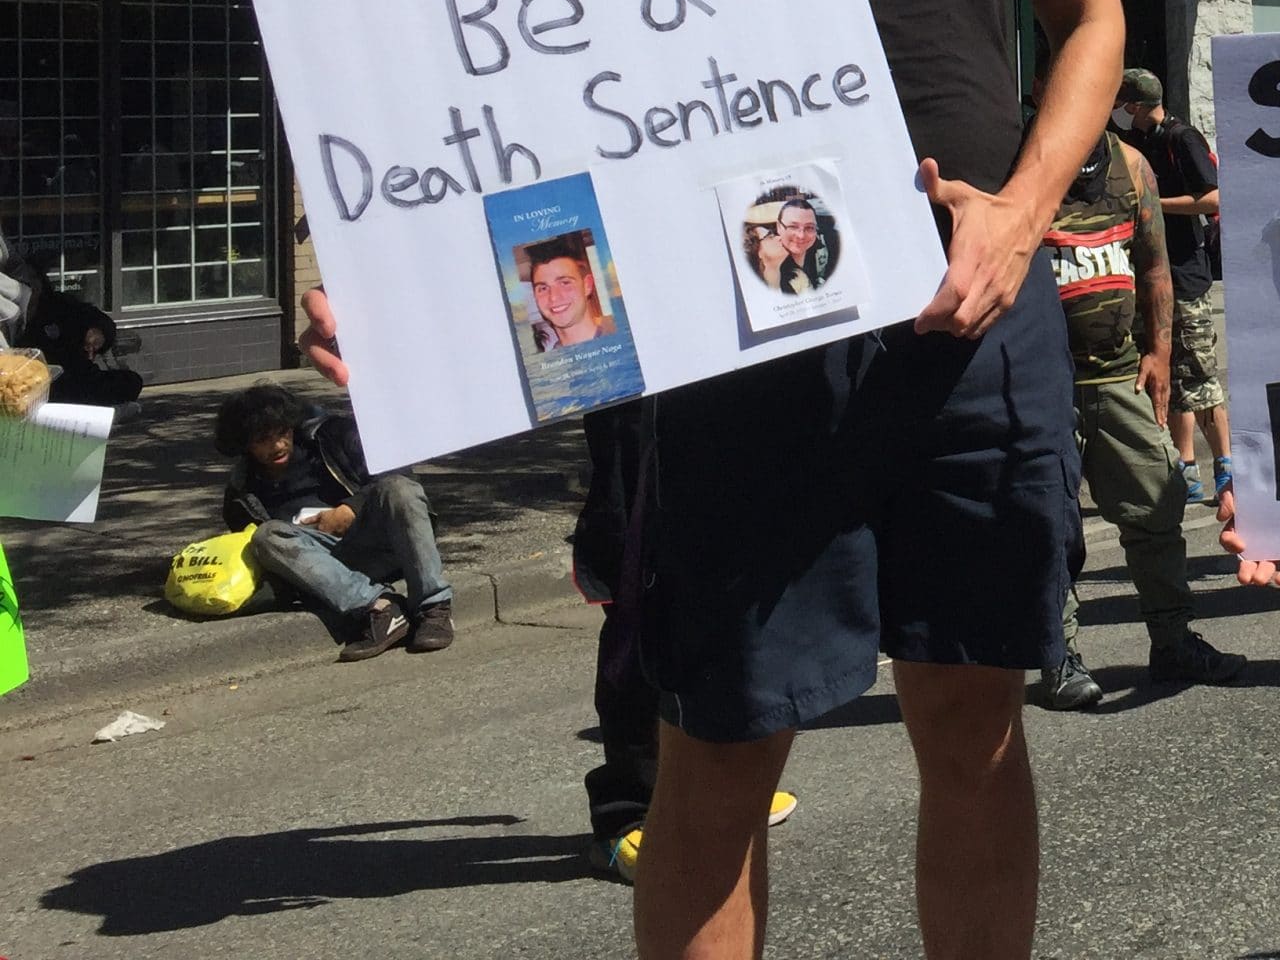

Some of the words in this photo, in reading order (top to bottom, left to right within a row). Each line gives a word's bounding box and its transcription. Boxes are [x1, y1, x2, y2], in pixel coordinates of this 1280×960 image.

[318, 105, 540, 222] Death
[584, 58, 870, 160] Sentence
[513, 213, 524, 223] IN
[526, 205, 561, 219] LOVING
[531, 215, 579, 232] Memory
[189, 555, 223, 567] BILL.
